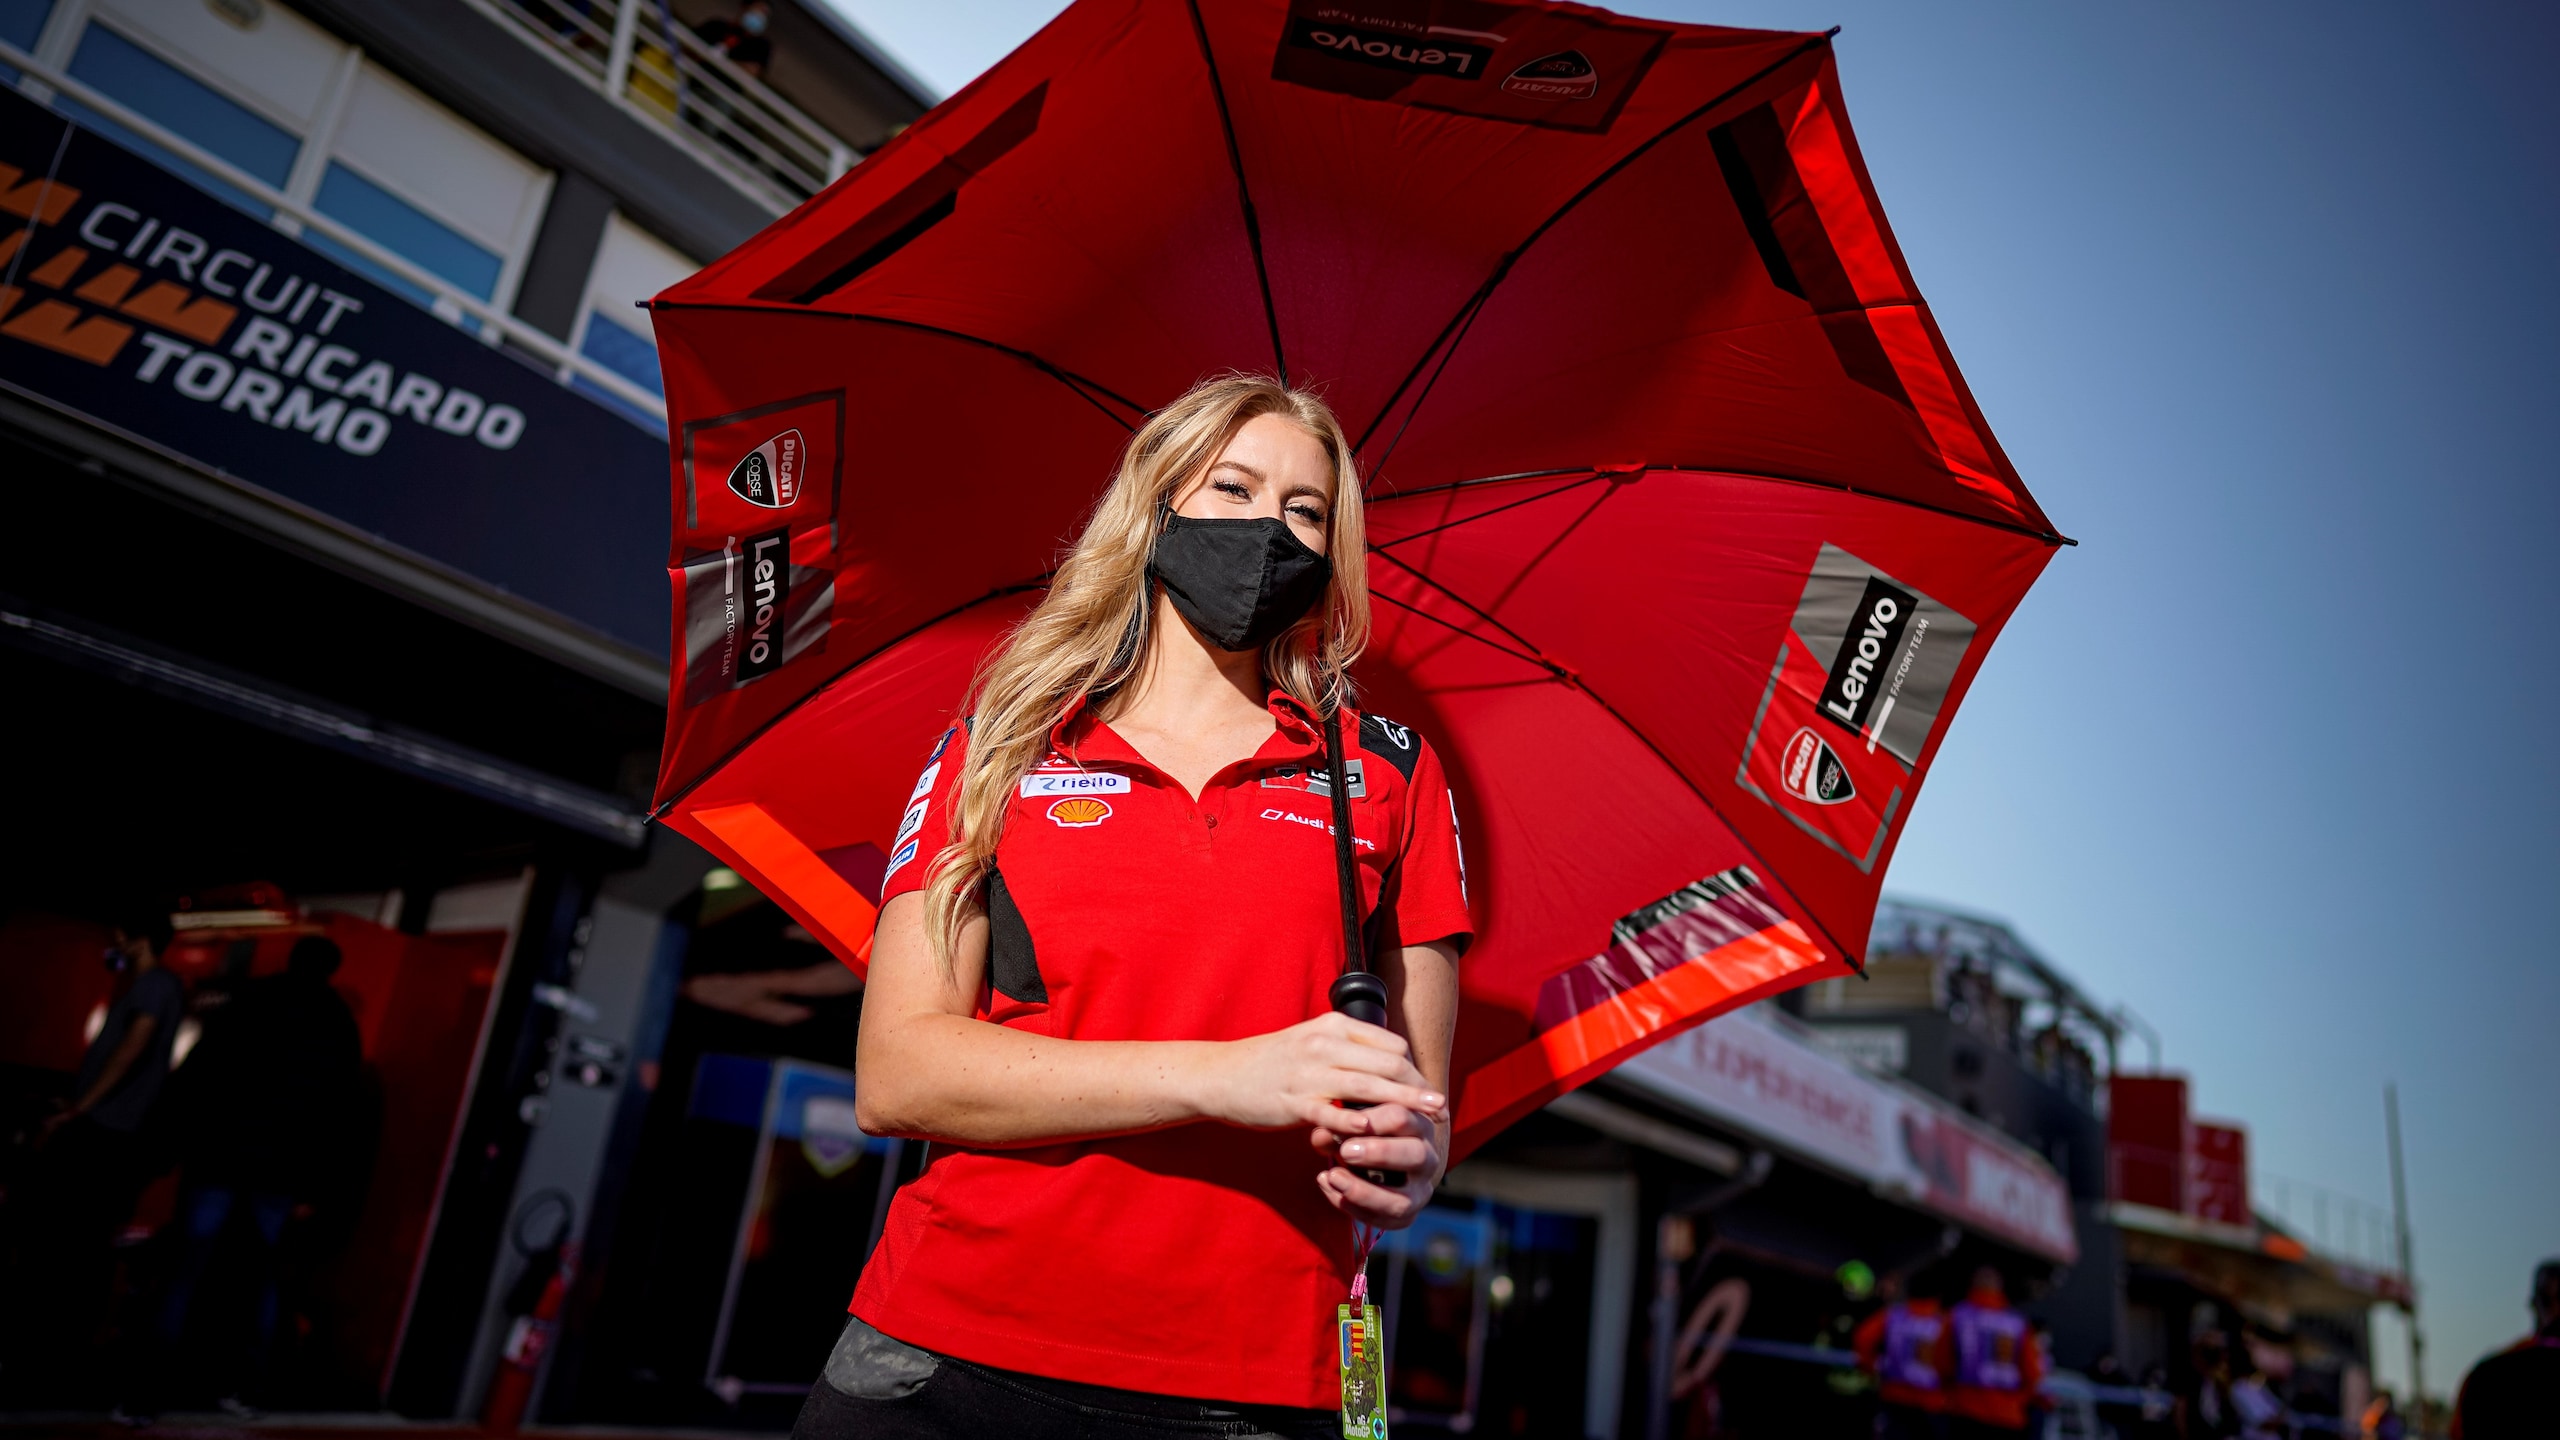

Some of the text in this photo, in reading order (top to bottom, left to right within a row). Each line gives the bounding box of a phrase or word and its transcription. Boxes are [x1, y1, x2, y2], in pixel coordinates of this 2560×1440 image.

[1310, 31, 1472, 73] Lenovo
[1360, 16, 1424, 33] FACTORY
[80, 202, 364, 335] CIRCUIT
[135, 331, 392, 457] TORMO
[231, 317, 527, 450] RICARDO
[750, 457, 762, 498] CORSE
[781, 439, 796, 498] DUCATI
[749, 536, 780, 664] Lenovo
[721, 597, 735, 677] FACTORY TEAM
[1828, 597, 1898, 721] Lenovo
[1890, 618, 1929, 697] FACTORY TEAM
[1062, 777, 1117, 789] riello
[1788, 735, 1815, 790] DUCATI
[1820, 761, 1839, 799] CORSE
[1284, 812, 1325, 830] Audi
